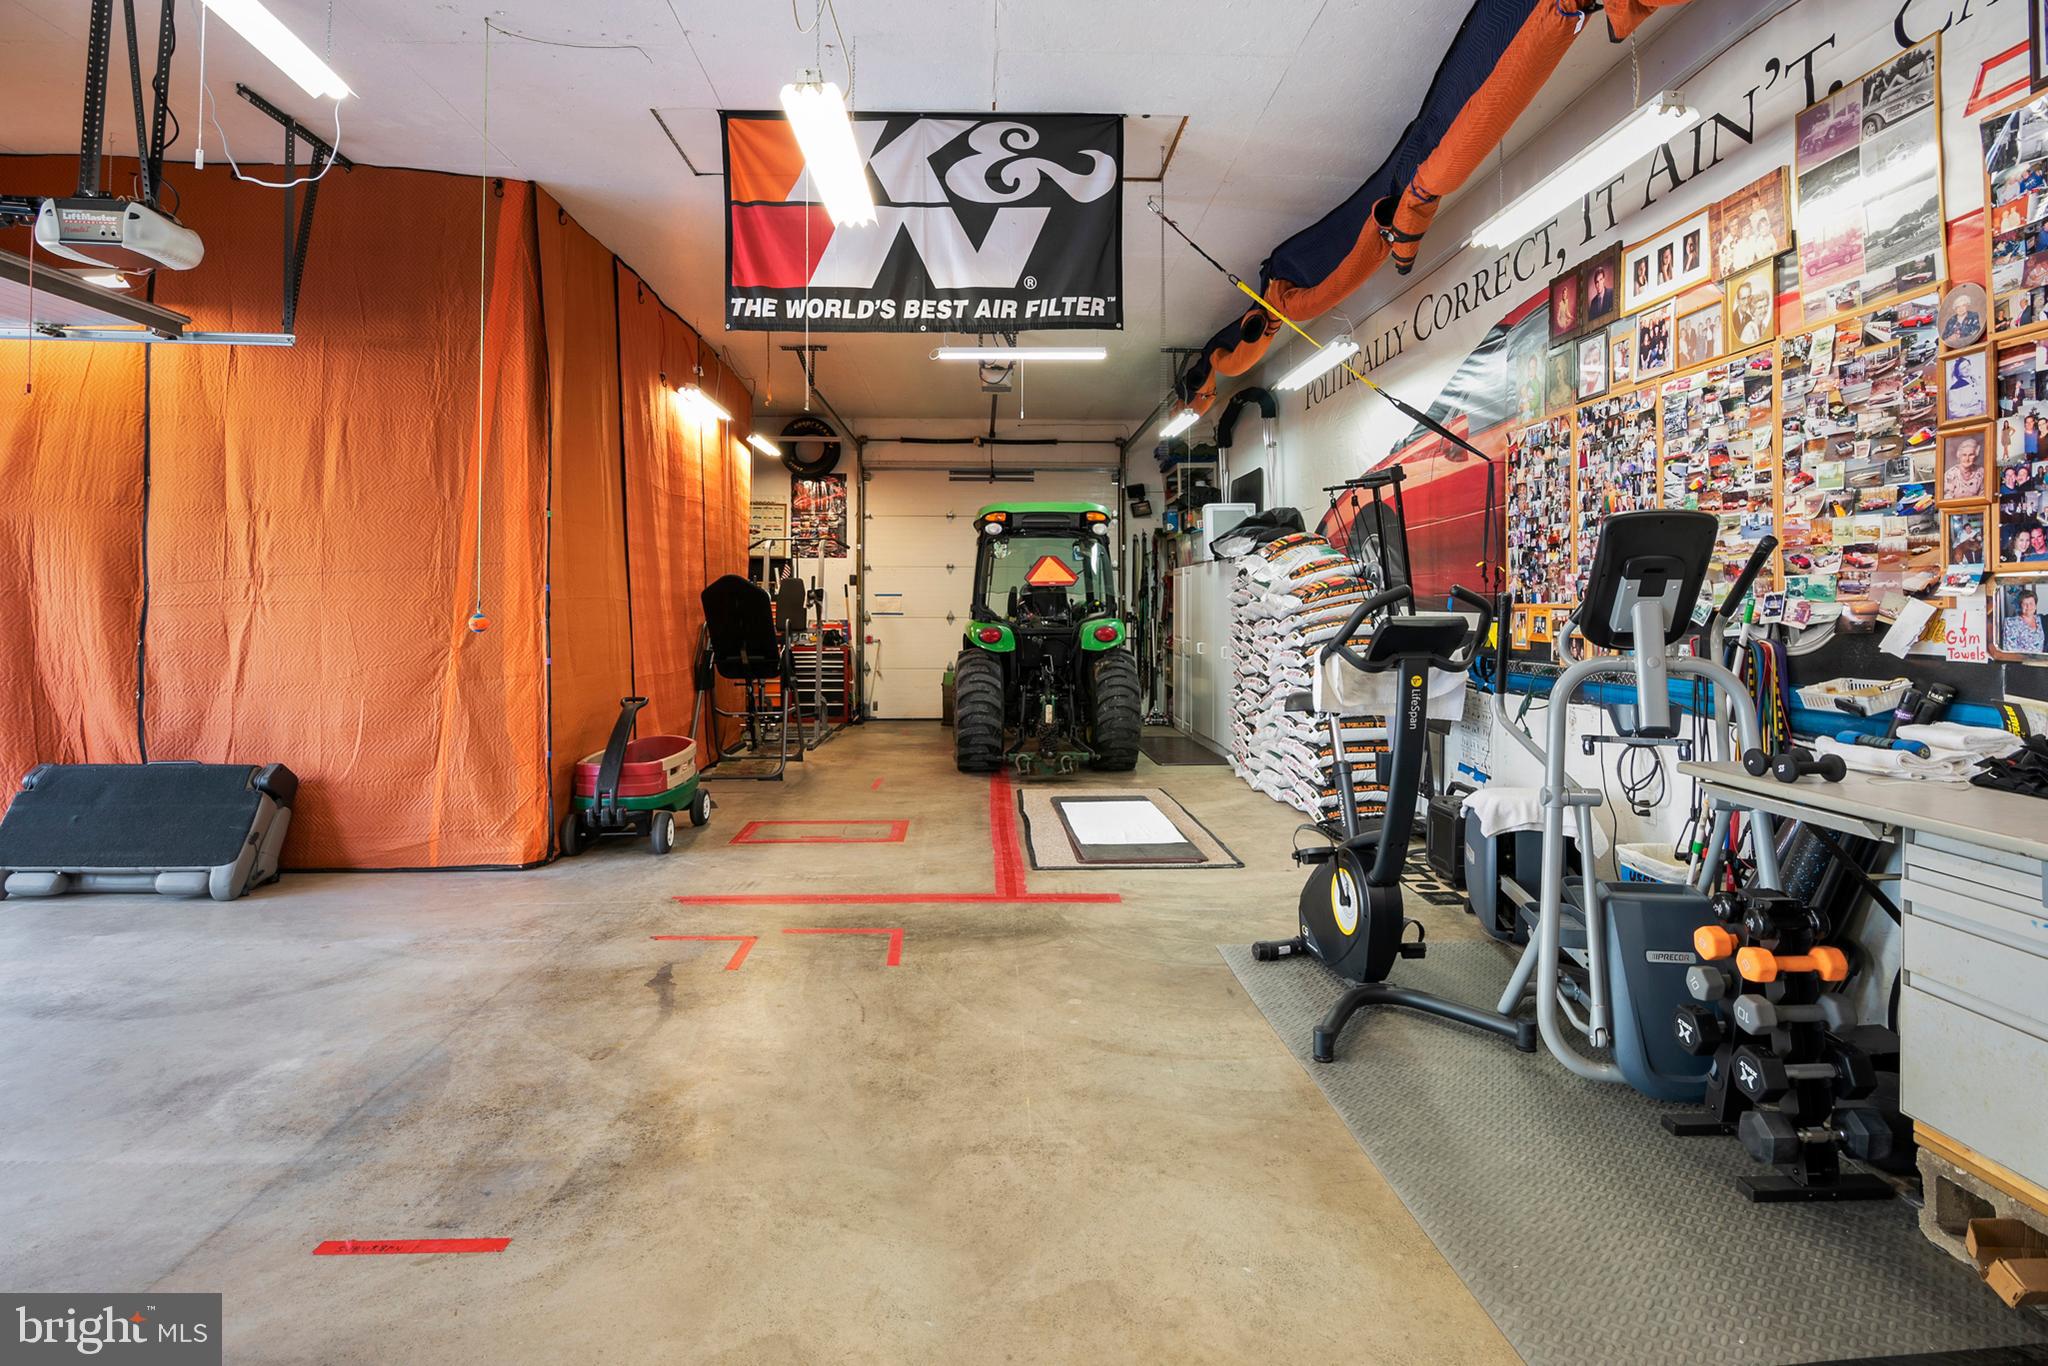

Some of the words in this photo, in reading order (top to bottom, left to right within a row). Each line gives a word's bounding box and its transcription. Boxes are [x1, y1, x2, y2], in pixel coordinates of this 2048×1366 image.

[1413, 214, 1566, 342] CORRECT,
[1579, 173, 1627, 246] IT
[732, 297, 778, 318] THE
[785, 299, 896, 320] WORLD'S
[903, 298, 969, 319] BEST
[974, 298, 1018, 319] AIR
[1945, 630, 1980, 648] Gym
[1946, 646, 1986, 660] Towels
[1408, 688, 1421, 730] LifeSpan
[1657, 952, 1690, 961] PRECOR
[1689, 975, 1701, 991] 10
